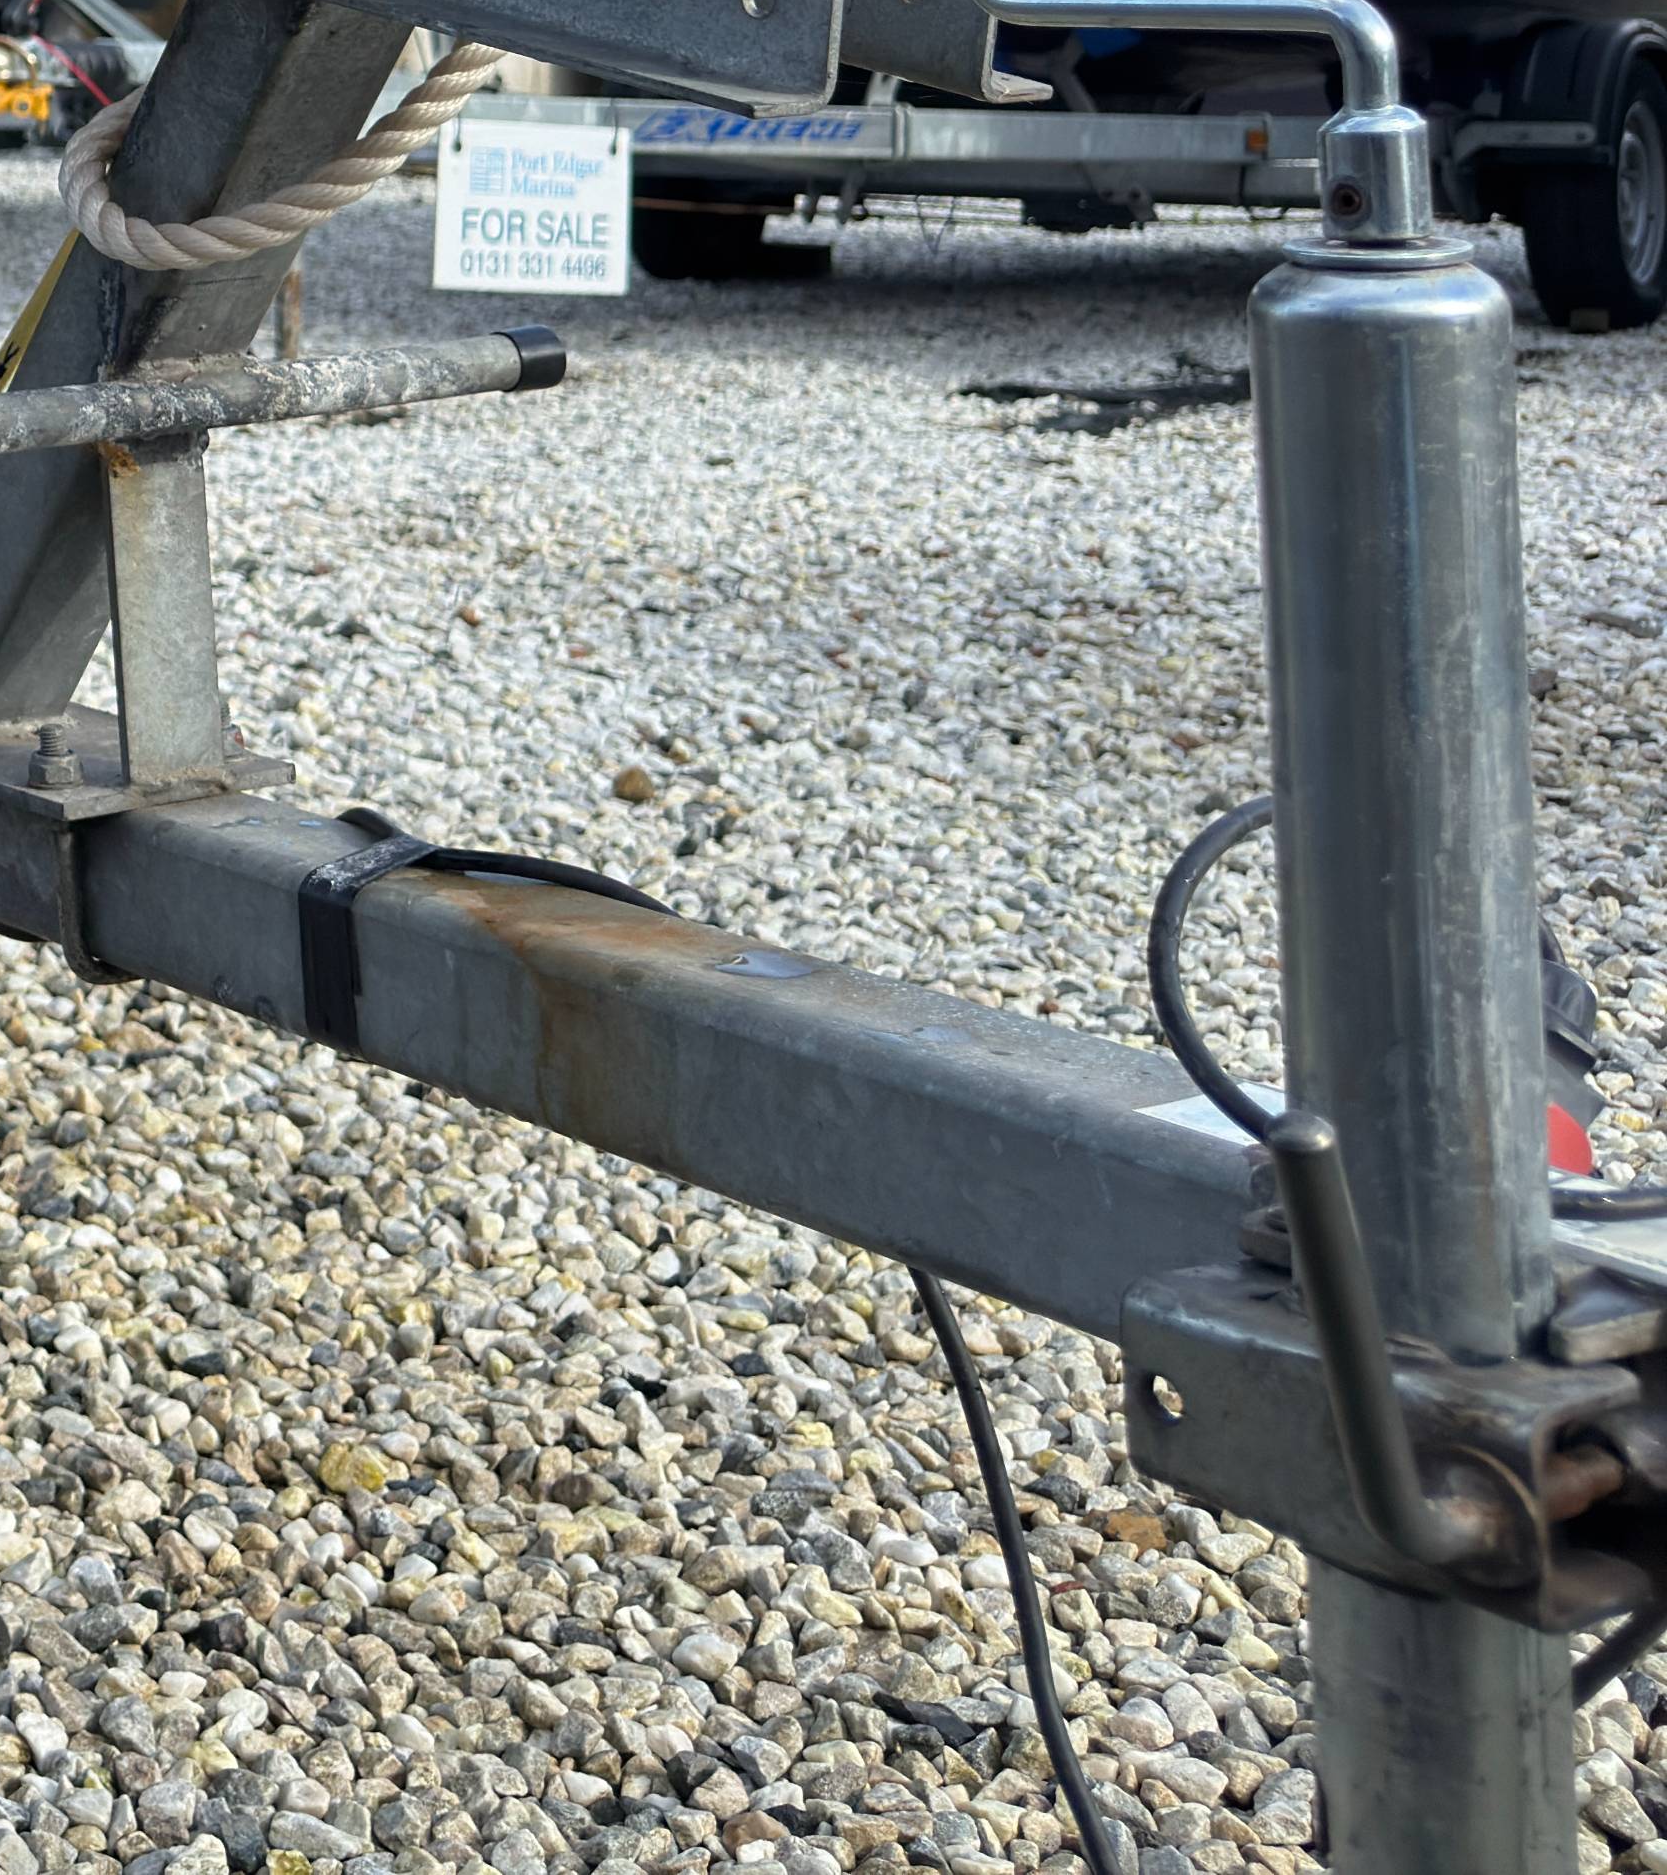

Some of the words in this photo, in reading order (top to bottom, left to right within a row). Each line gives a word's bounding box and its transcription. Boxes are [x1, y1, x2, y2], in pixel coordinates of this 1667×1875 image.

[461, 207, 526, 244] FOR
[535, 209, 609, 248] SALE
[459, 249, 510, 277] 0131
[518, 251, 554, 278] 331
